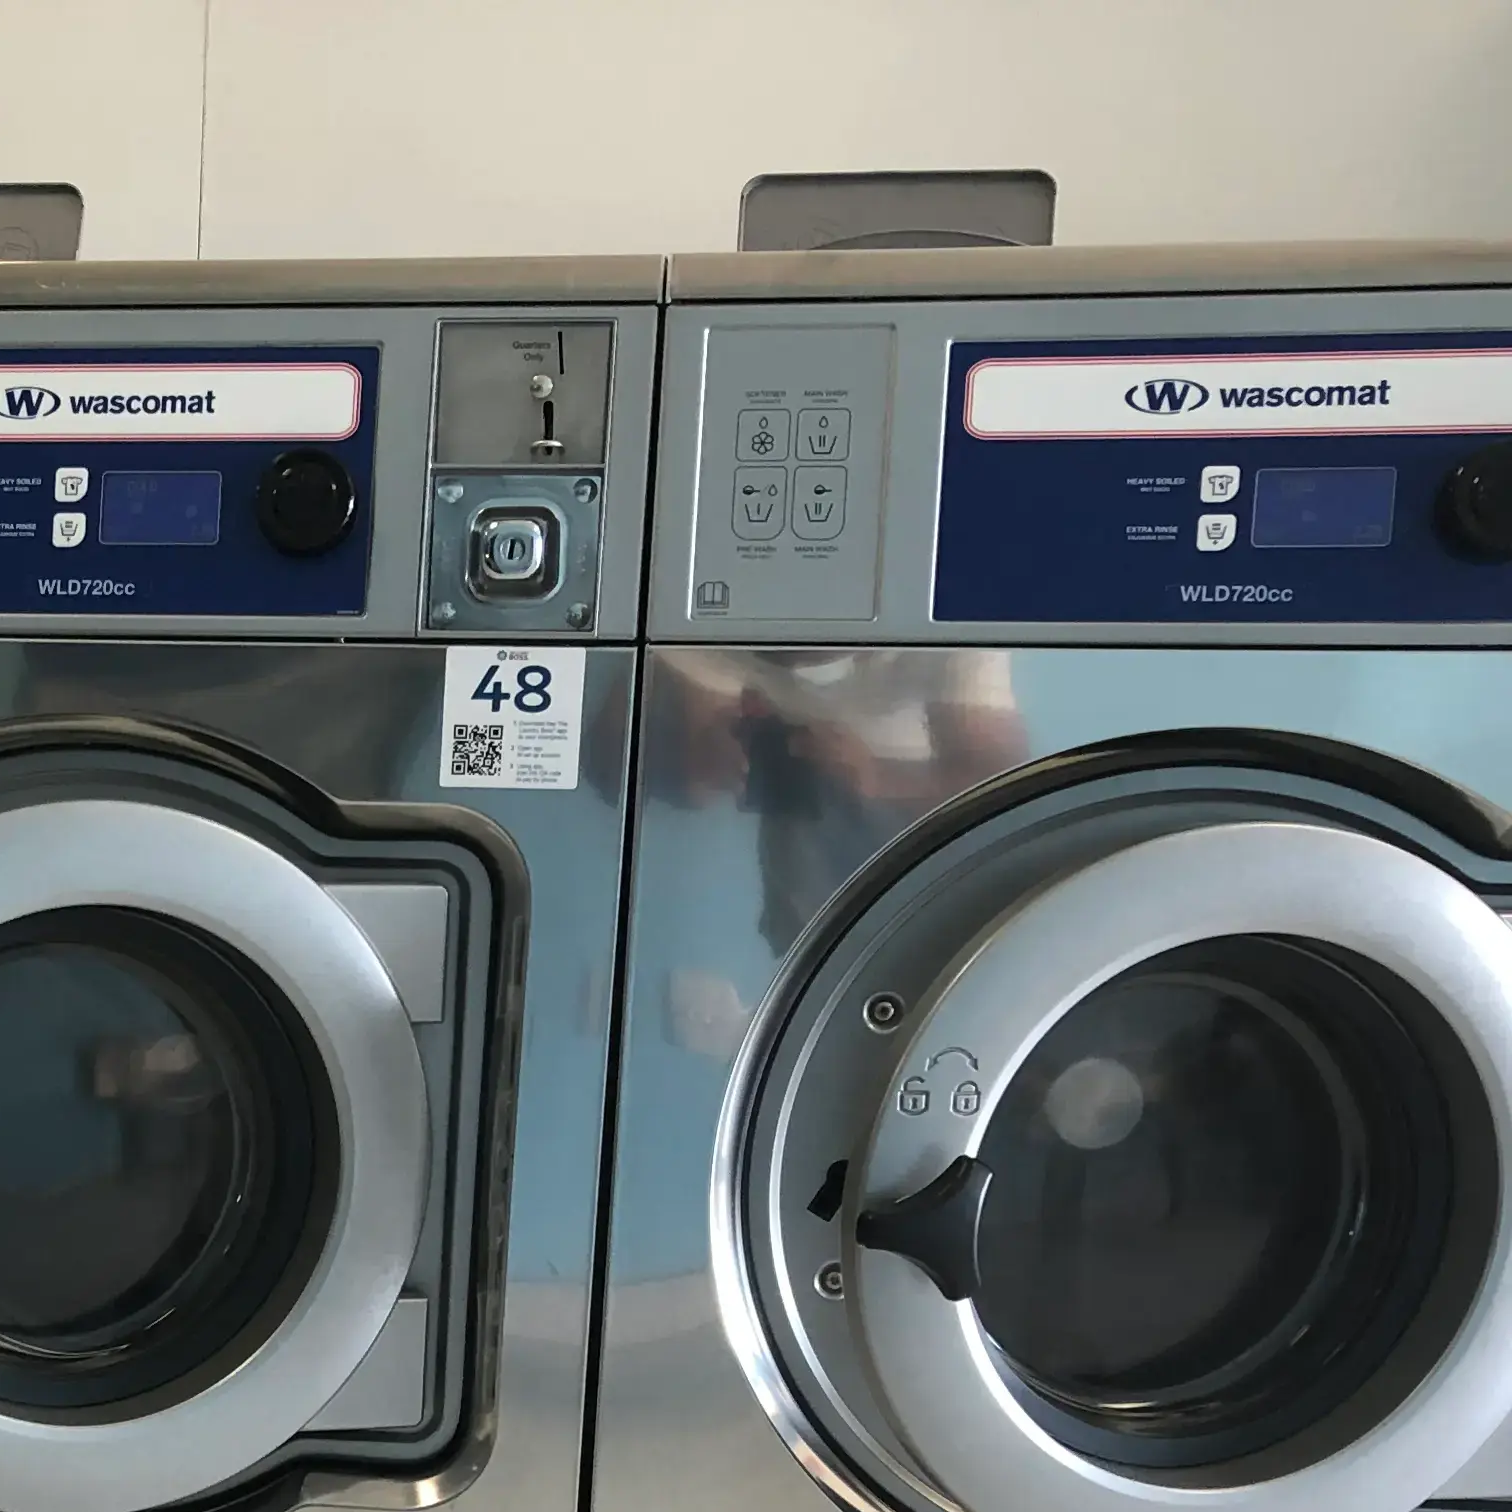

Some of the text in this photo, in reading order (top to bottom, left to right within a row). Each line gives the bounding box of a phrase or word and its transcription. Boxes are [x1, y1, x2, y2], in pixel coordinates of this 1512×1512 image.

[512, 341, 551, 350] Quarters
[524, 353, 543, 362] Only
[70, 390, 216, 414] wascomat
[1220, 380, 1391, 408] wascomat
[38, 579, 136, 595] WLD720cc
[1180, 585, 1293, 602] WLD720cc
[471, 665, 552, 713] 48
